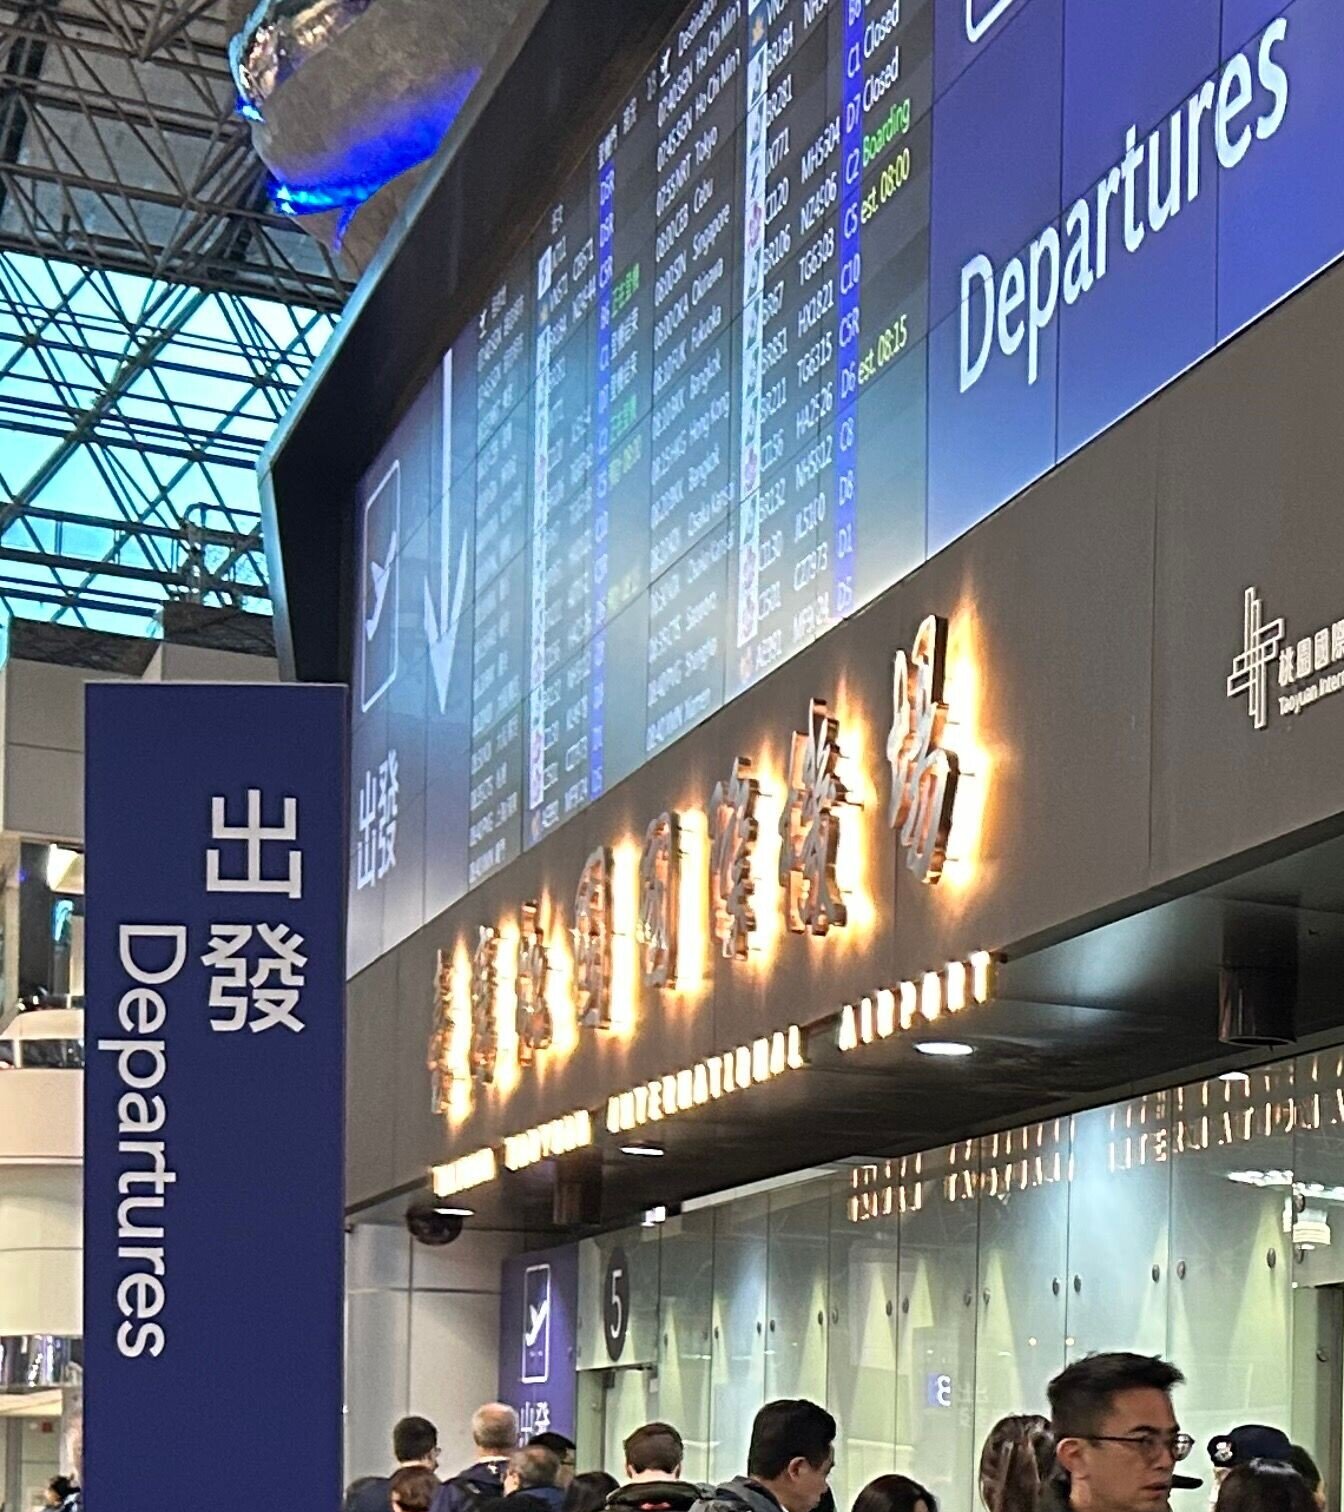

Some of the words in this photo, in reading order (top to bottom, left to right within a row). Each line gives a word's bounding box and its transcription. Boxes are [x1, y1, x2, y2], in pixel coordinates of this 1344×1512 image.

[863, 0, 899, 58] Closed
[863, 46, 898, 111] Closed
[846, 146, 859, 185] C2
[863, 95, 910, 168] Boarding
[880, 145, 910, 203] 08:00
[959, 17, 1289, 393] Departures
[877, 313, 906, 366] 08:15
[1279, 684, 1318, 716] Taoyuan
[357, 749, 399, 890] 出發
[201, 789, 309, 1034] 出發
[98, 922, 188, 1360] Departures
[610, 1268, 625, 1342] 5
